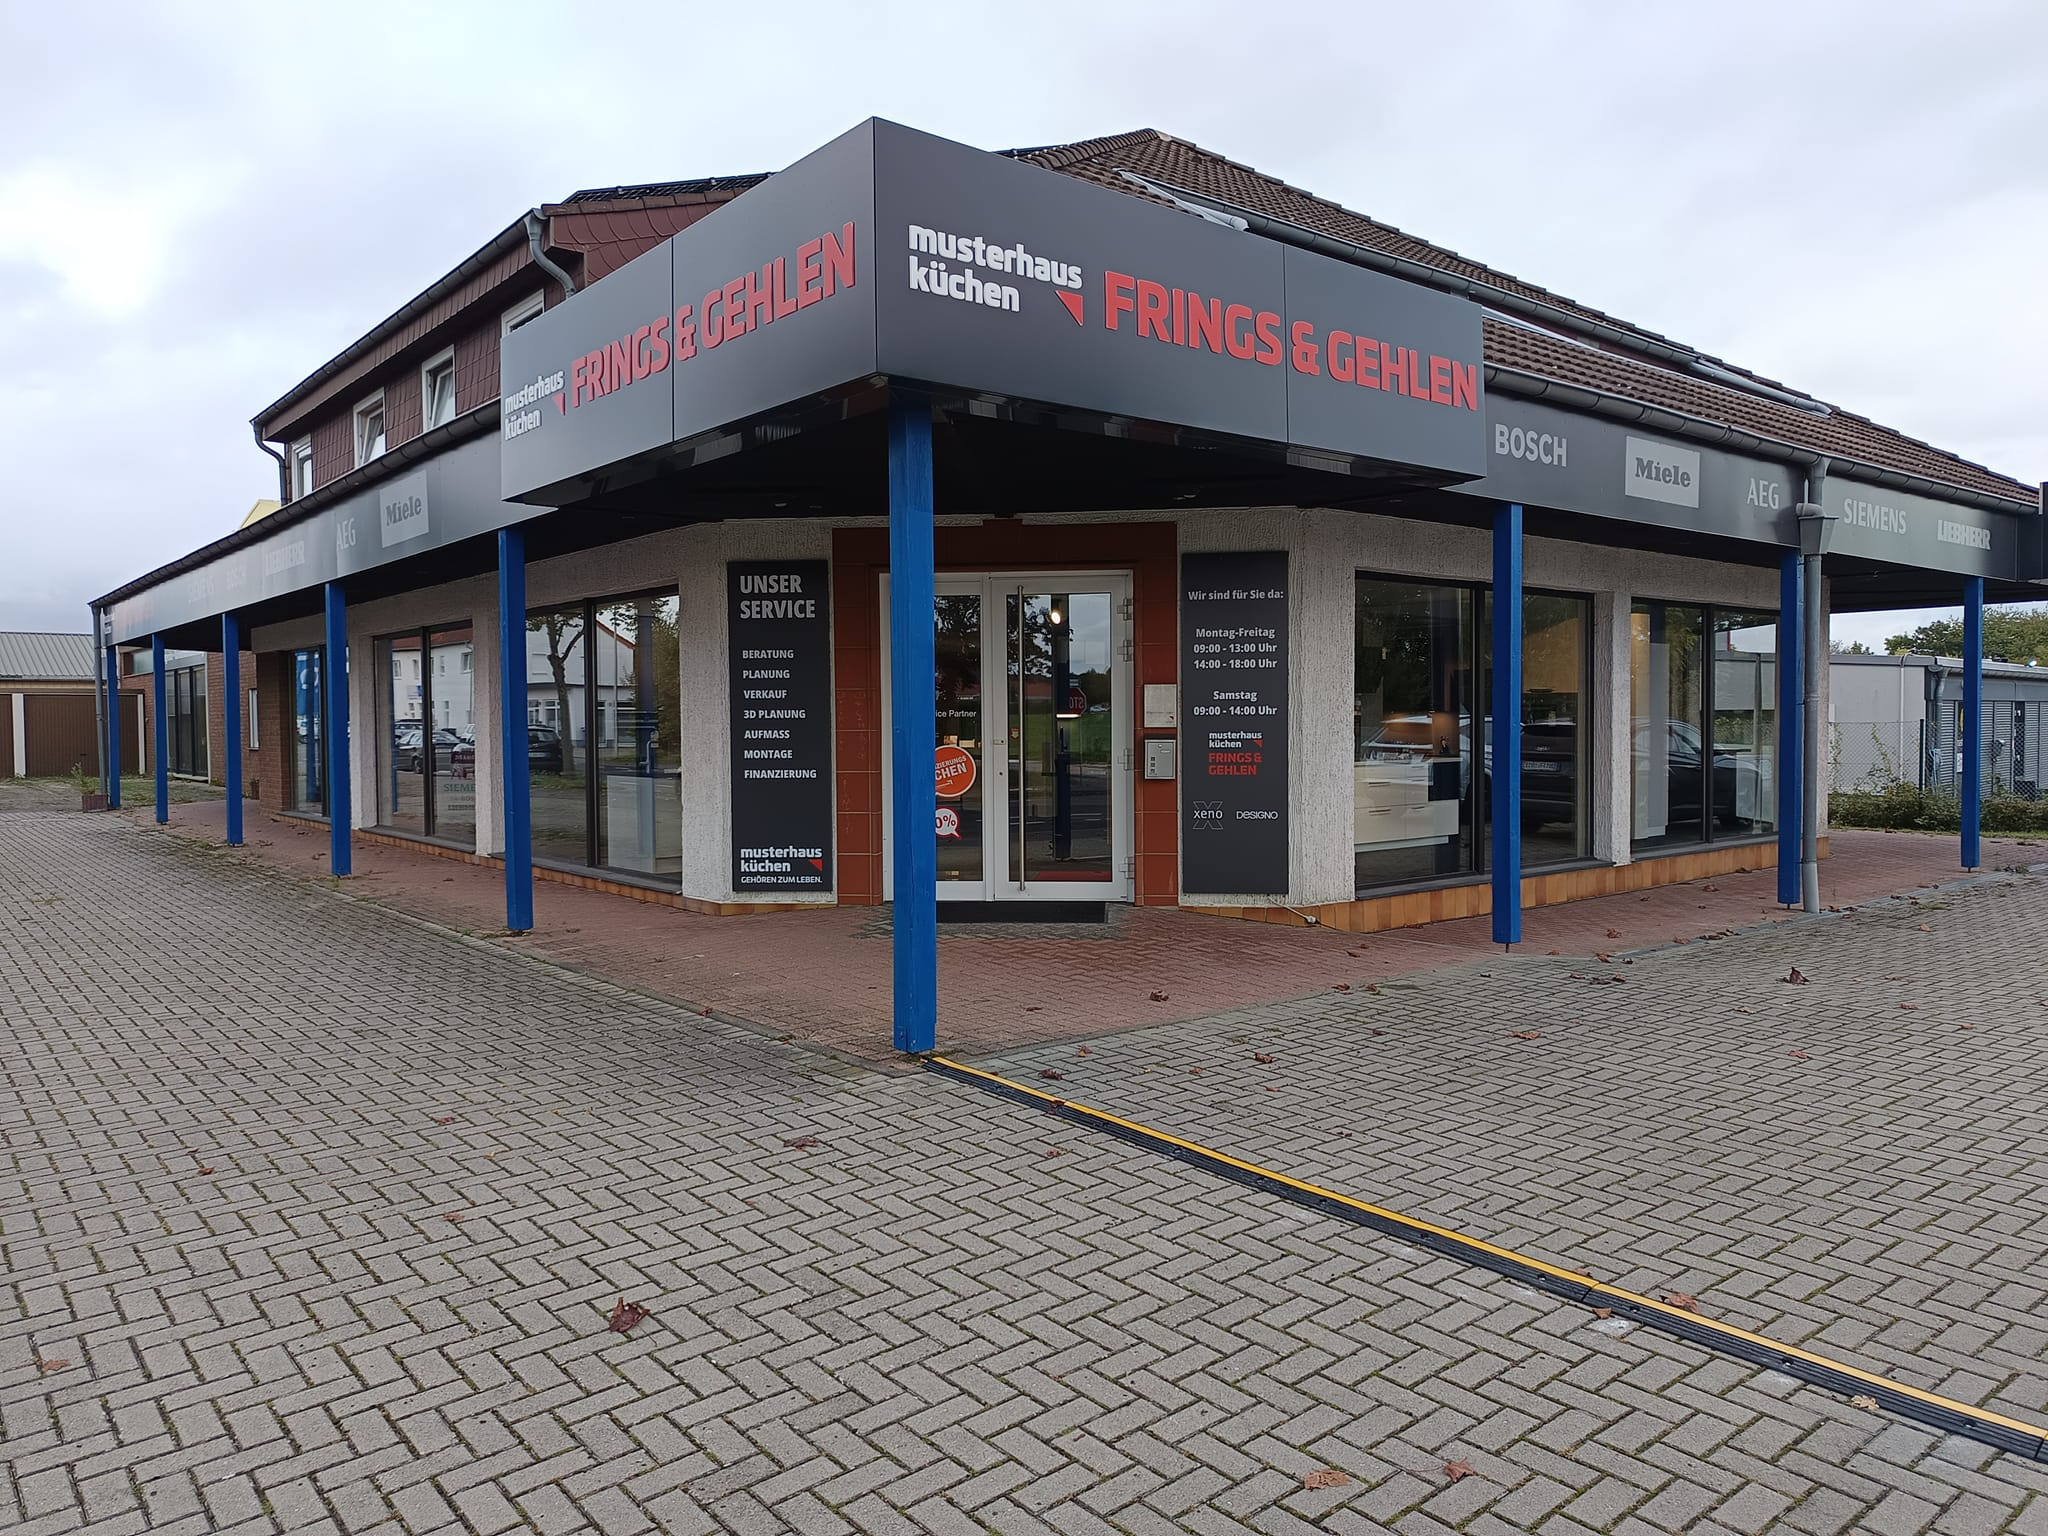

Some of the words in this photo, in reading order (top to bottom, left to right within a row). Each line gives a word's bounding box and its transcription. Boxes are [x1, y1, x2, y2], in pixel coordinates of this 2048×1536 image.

[909, 224, 1083, 289] musterhaus
[909, 255, 1020, 313] küchen
[571, 316, 671, 408] FRINGS
[676, 304, 697, 361] &
[701, 221, 856, 349] GEHLEN
[1104, 270, 1283, 366] FRINGS
[1290, 320, 1321, 376] &
[1326, 329, 1478, 411] GEHLEN
[504, 370, 564, 415] musterhaus
[504, 410, 541, 441] küchen
[1495, 423, 1567, 467] BOSCH
[1635, 457, 1692, 488] Miele
[1747, 478, 1780, 510] AEG
[385, 495, 422, 527] Miele
[1844, 498, 1907, 535] SIEMENS
[336, 517, 356, 550] AEG
[1937, 519, 1991, 550] LIEBHERR
[740, 575, 802, 594] UNSER
[1188, 591, 1207, 600] Wir
[1208, 590, 1230, 600] sind
[1232, 590, 1248, 600] für
[1250, 589, 1265, 599] Sie
[1267, 589, 1284, 599] da:
[740, 599, 816, 619] SERVICE
[1195, 627, 1275, 640] Montag-Freitag
[1193, 644, 1221, 653] 09:00
[1229, 643, 1256, 653] 13:00
[1258, 643, 1278, 652] Uhr
[742, 650, 794, 659] BERATUNG
[1193, 659, 1221, 669] 14:00
[1229, 659, 1256, 669] 18:00
[1258, 659, 1278, 668] Uhr
[743, 670, 790, 679] PLANUNG
[743, 690, 787, 699] VERKAUF
[1213, 690, 1258, 701] Samstag
[743, 710, 757, 719] 3D
[758, 710, 806, 719] PLANUNG
[948, 709, 977, 718] Partner
[1193, 706, 1221, 716] 09:00
[1229, 706, 1256, 715] 14:00
[1258, 705, 1278, 715] Uhr
[744, 730, 790, 739] AUFMASS
[1208, 731, 1262, 739] musterhaus
[1208, 740, 1242, 748] küchen
[744, 750, 793, 759] MONTAGE
[1208, 752, 1253, 763] FRINGS
[1254, 753, 1263, 763] &
[744, 769, 817, 779] FINANZIERUNG
[935, 763, 967, 781] CHEN
[1208, 765, 1257, 775] GEHLEN
[1193, 809, 1223, 819] xeno
[740, 845, 822, 858] musterhaus
[740, 859, 791, 872] küchen
[740, 874, 777, 884] GEHÖREN
[777, 876, 795, 884] ZUM
[796, 876, 823, 884] LEBEN.
